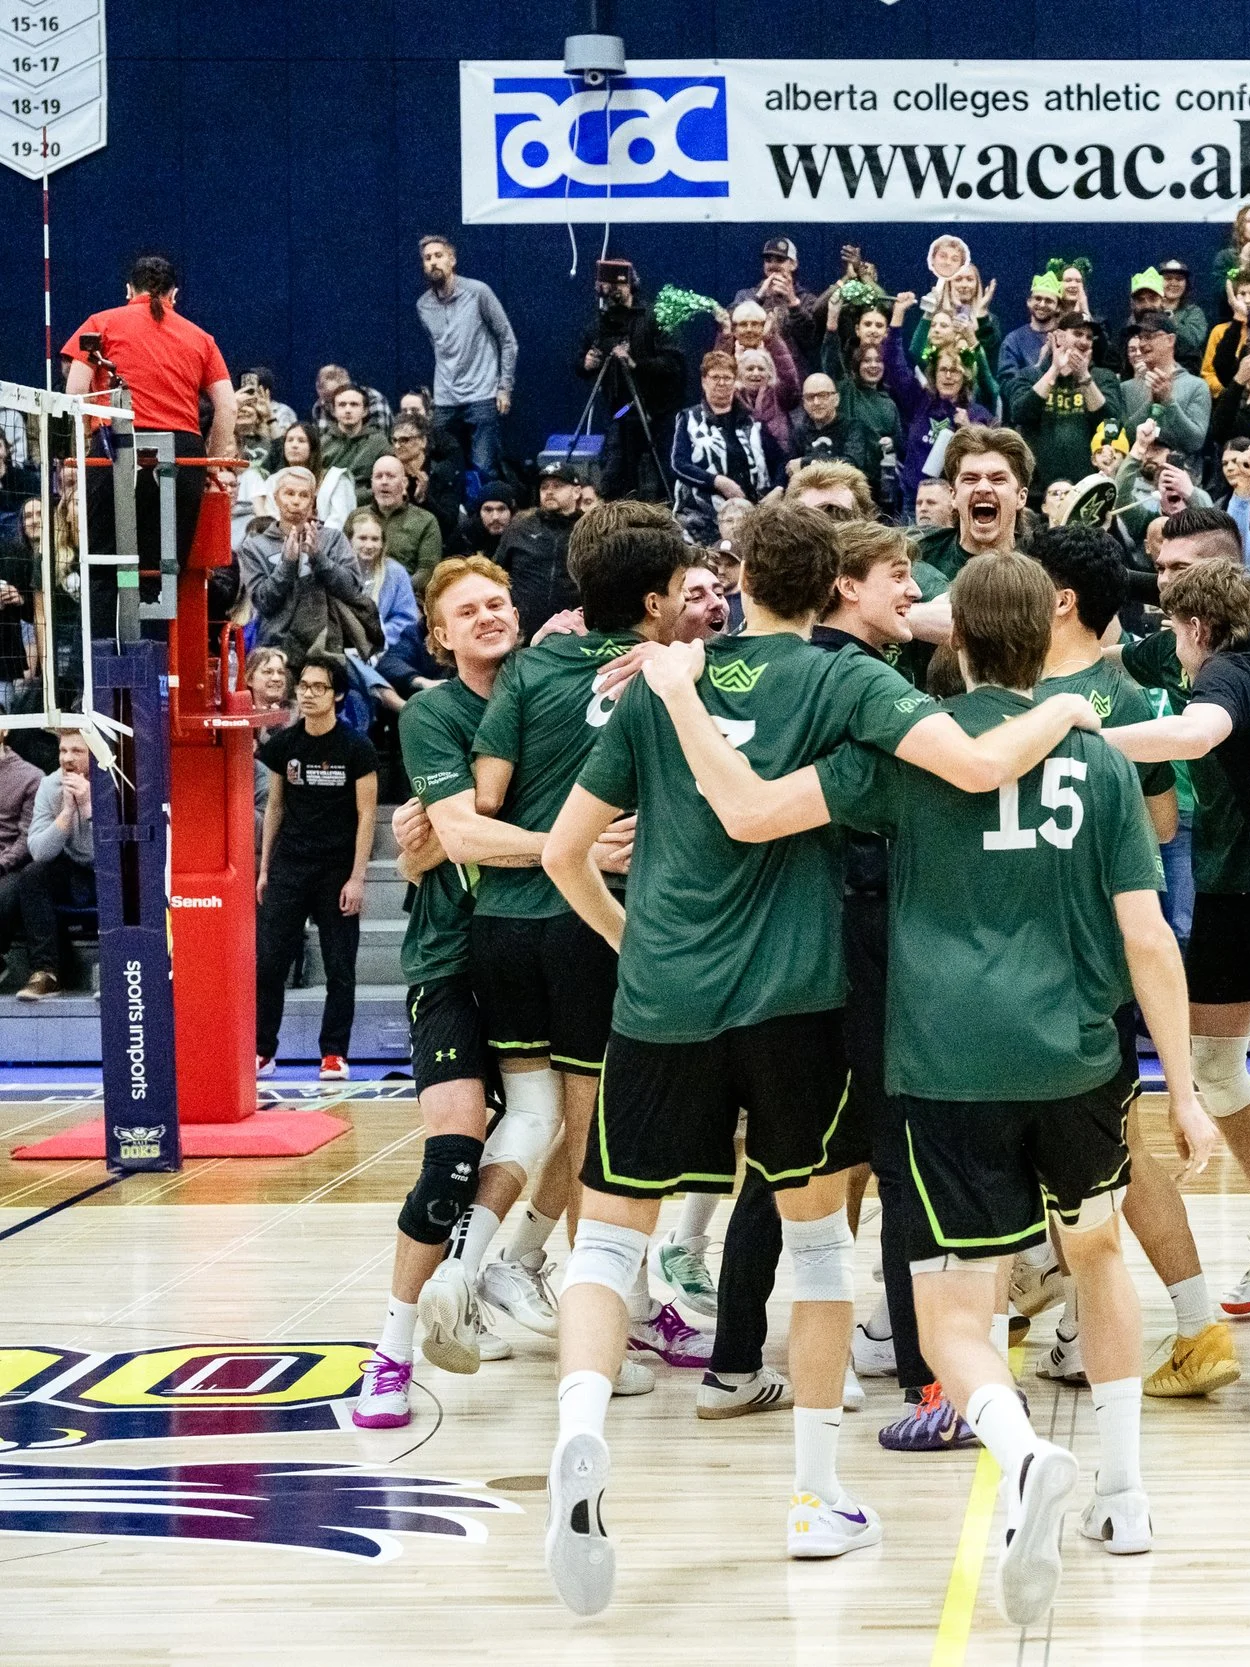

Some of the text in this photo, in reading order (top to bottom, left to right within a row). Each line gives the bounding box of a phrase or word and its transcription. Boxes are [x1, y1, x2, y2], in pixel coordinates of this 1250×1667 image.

[11, 16, 59, 32] 15-16
[12, 57, 60, 72] 16-17
[12, 99, 61, 114] 18-19
[765, 83, 878, 111] alberta
[893, 83, 1029, 118] colleges
[1044, 83, 1160, 111] athletic
[983, 757, 1088, 850] 15
[170, 896, 223, 908] Senoh
[123, 960, 146, 1022] sports
